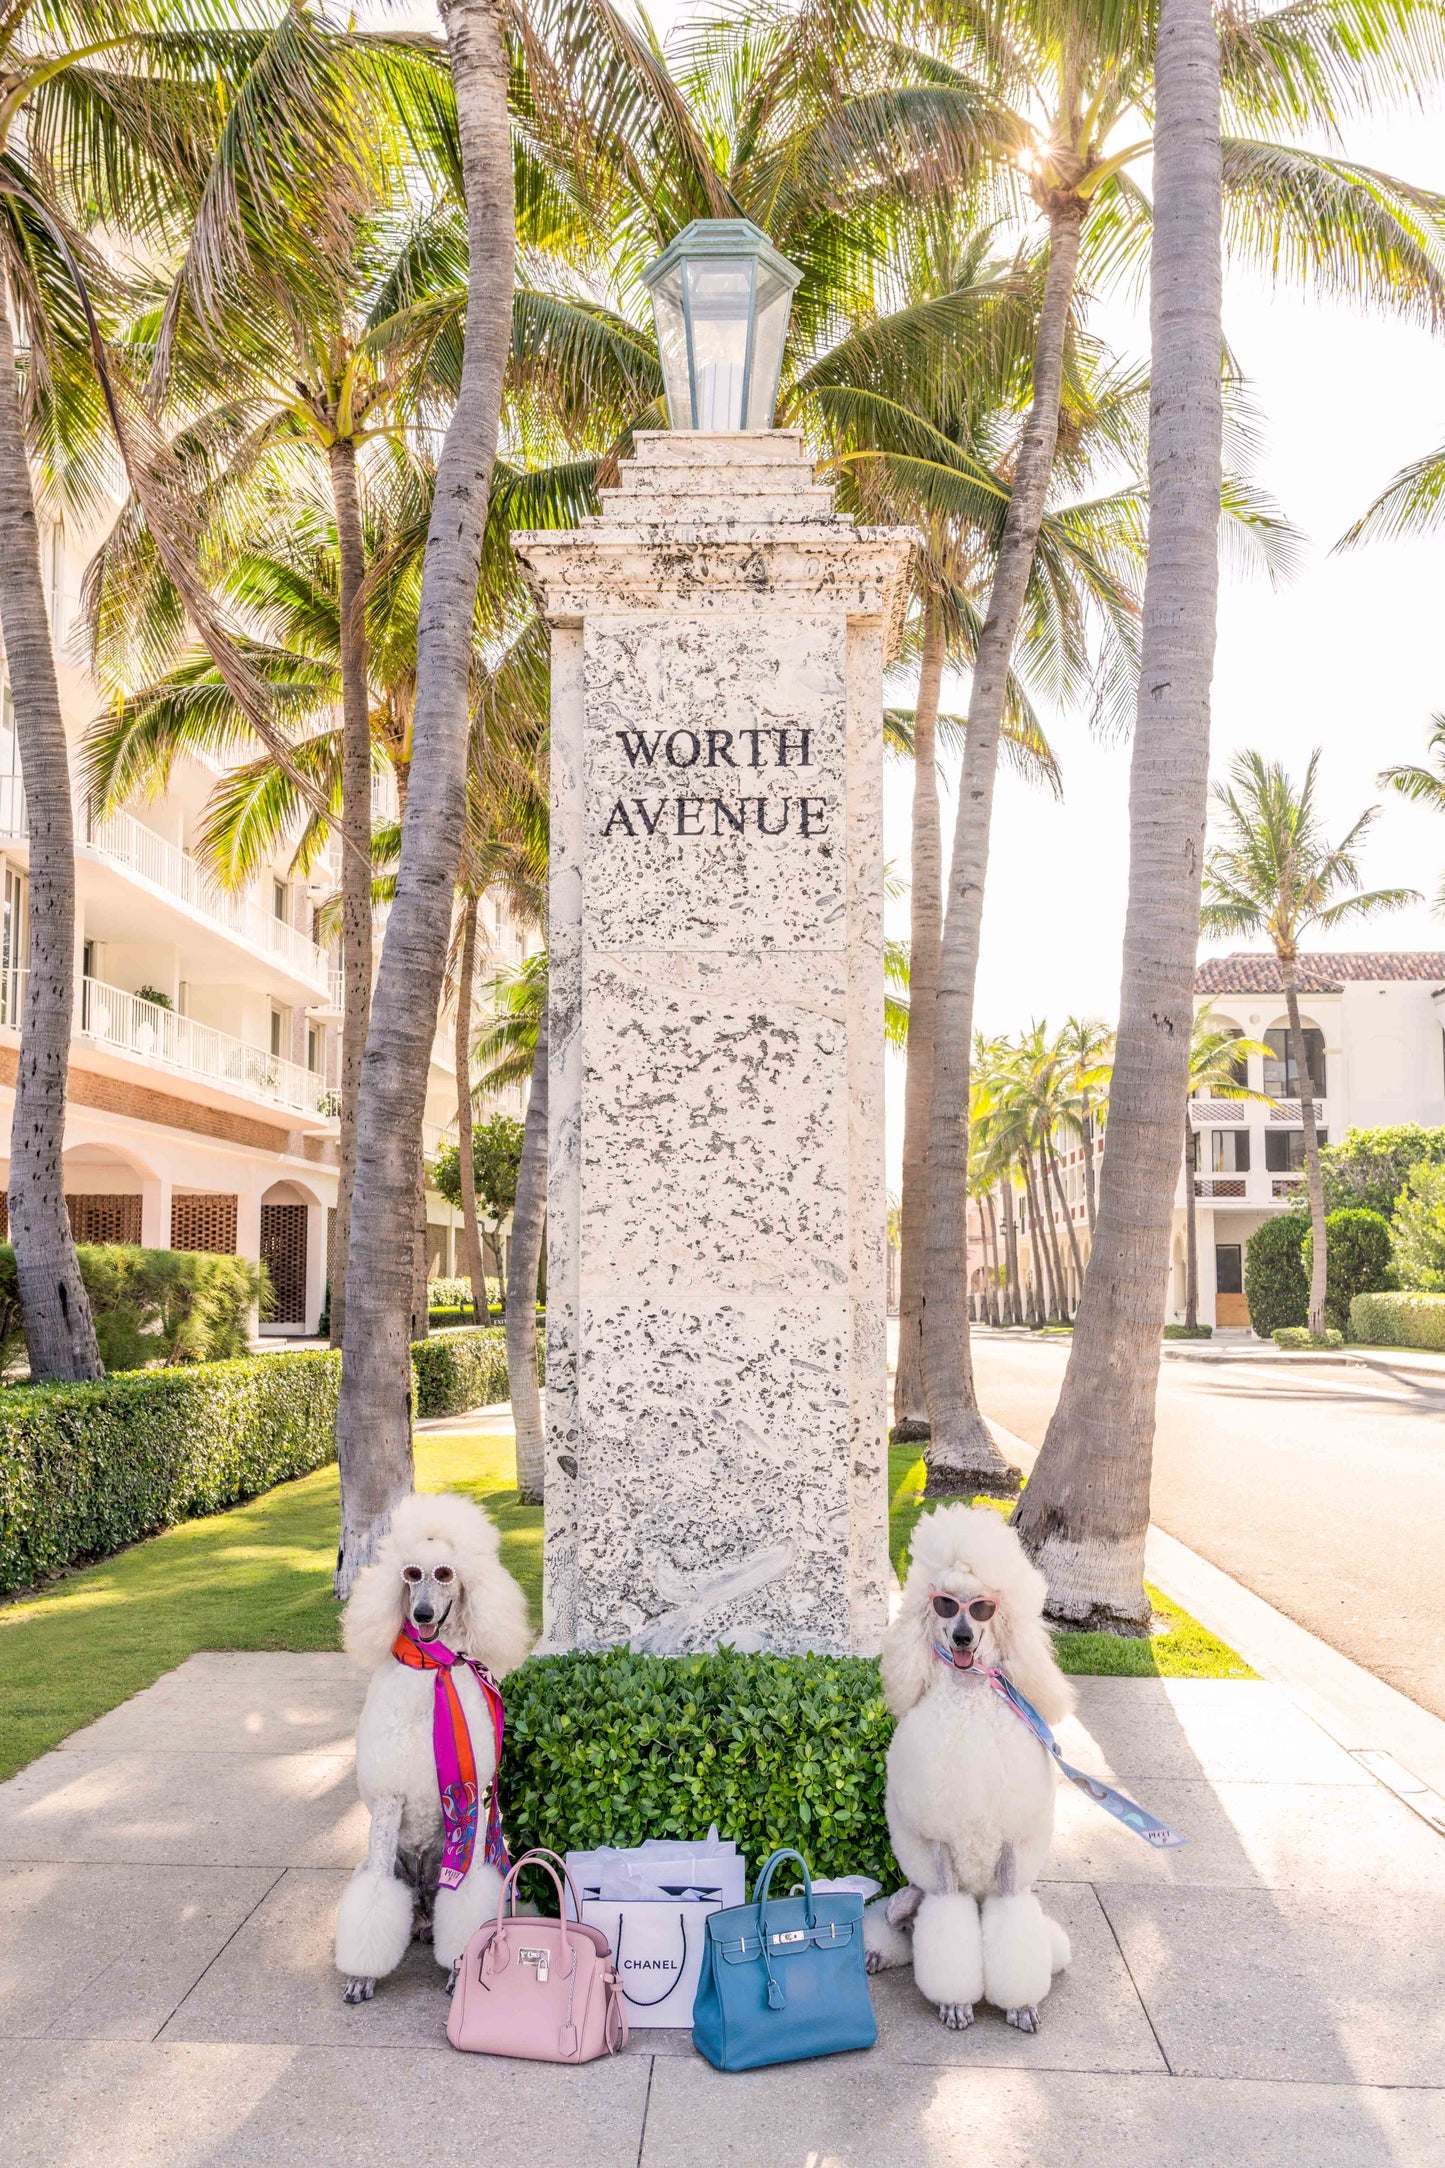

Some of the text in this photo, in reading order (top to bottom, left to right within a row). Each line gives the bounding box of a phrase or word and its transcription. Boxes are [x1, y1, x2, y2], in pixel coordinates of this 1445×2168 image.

[615, 728, 815, 768] WORTH
[600, 796, 830, 836] AVENUE
[623, 1959, 678, 1970] CHANEL
